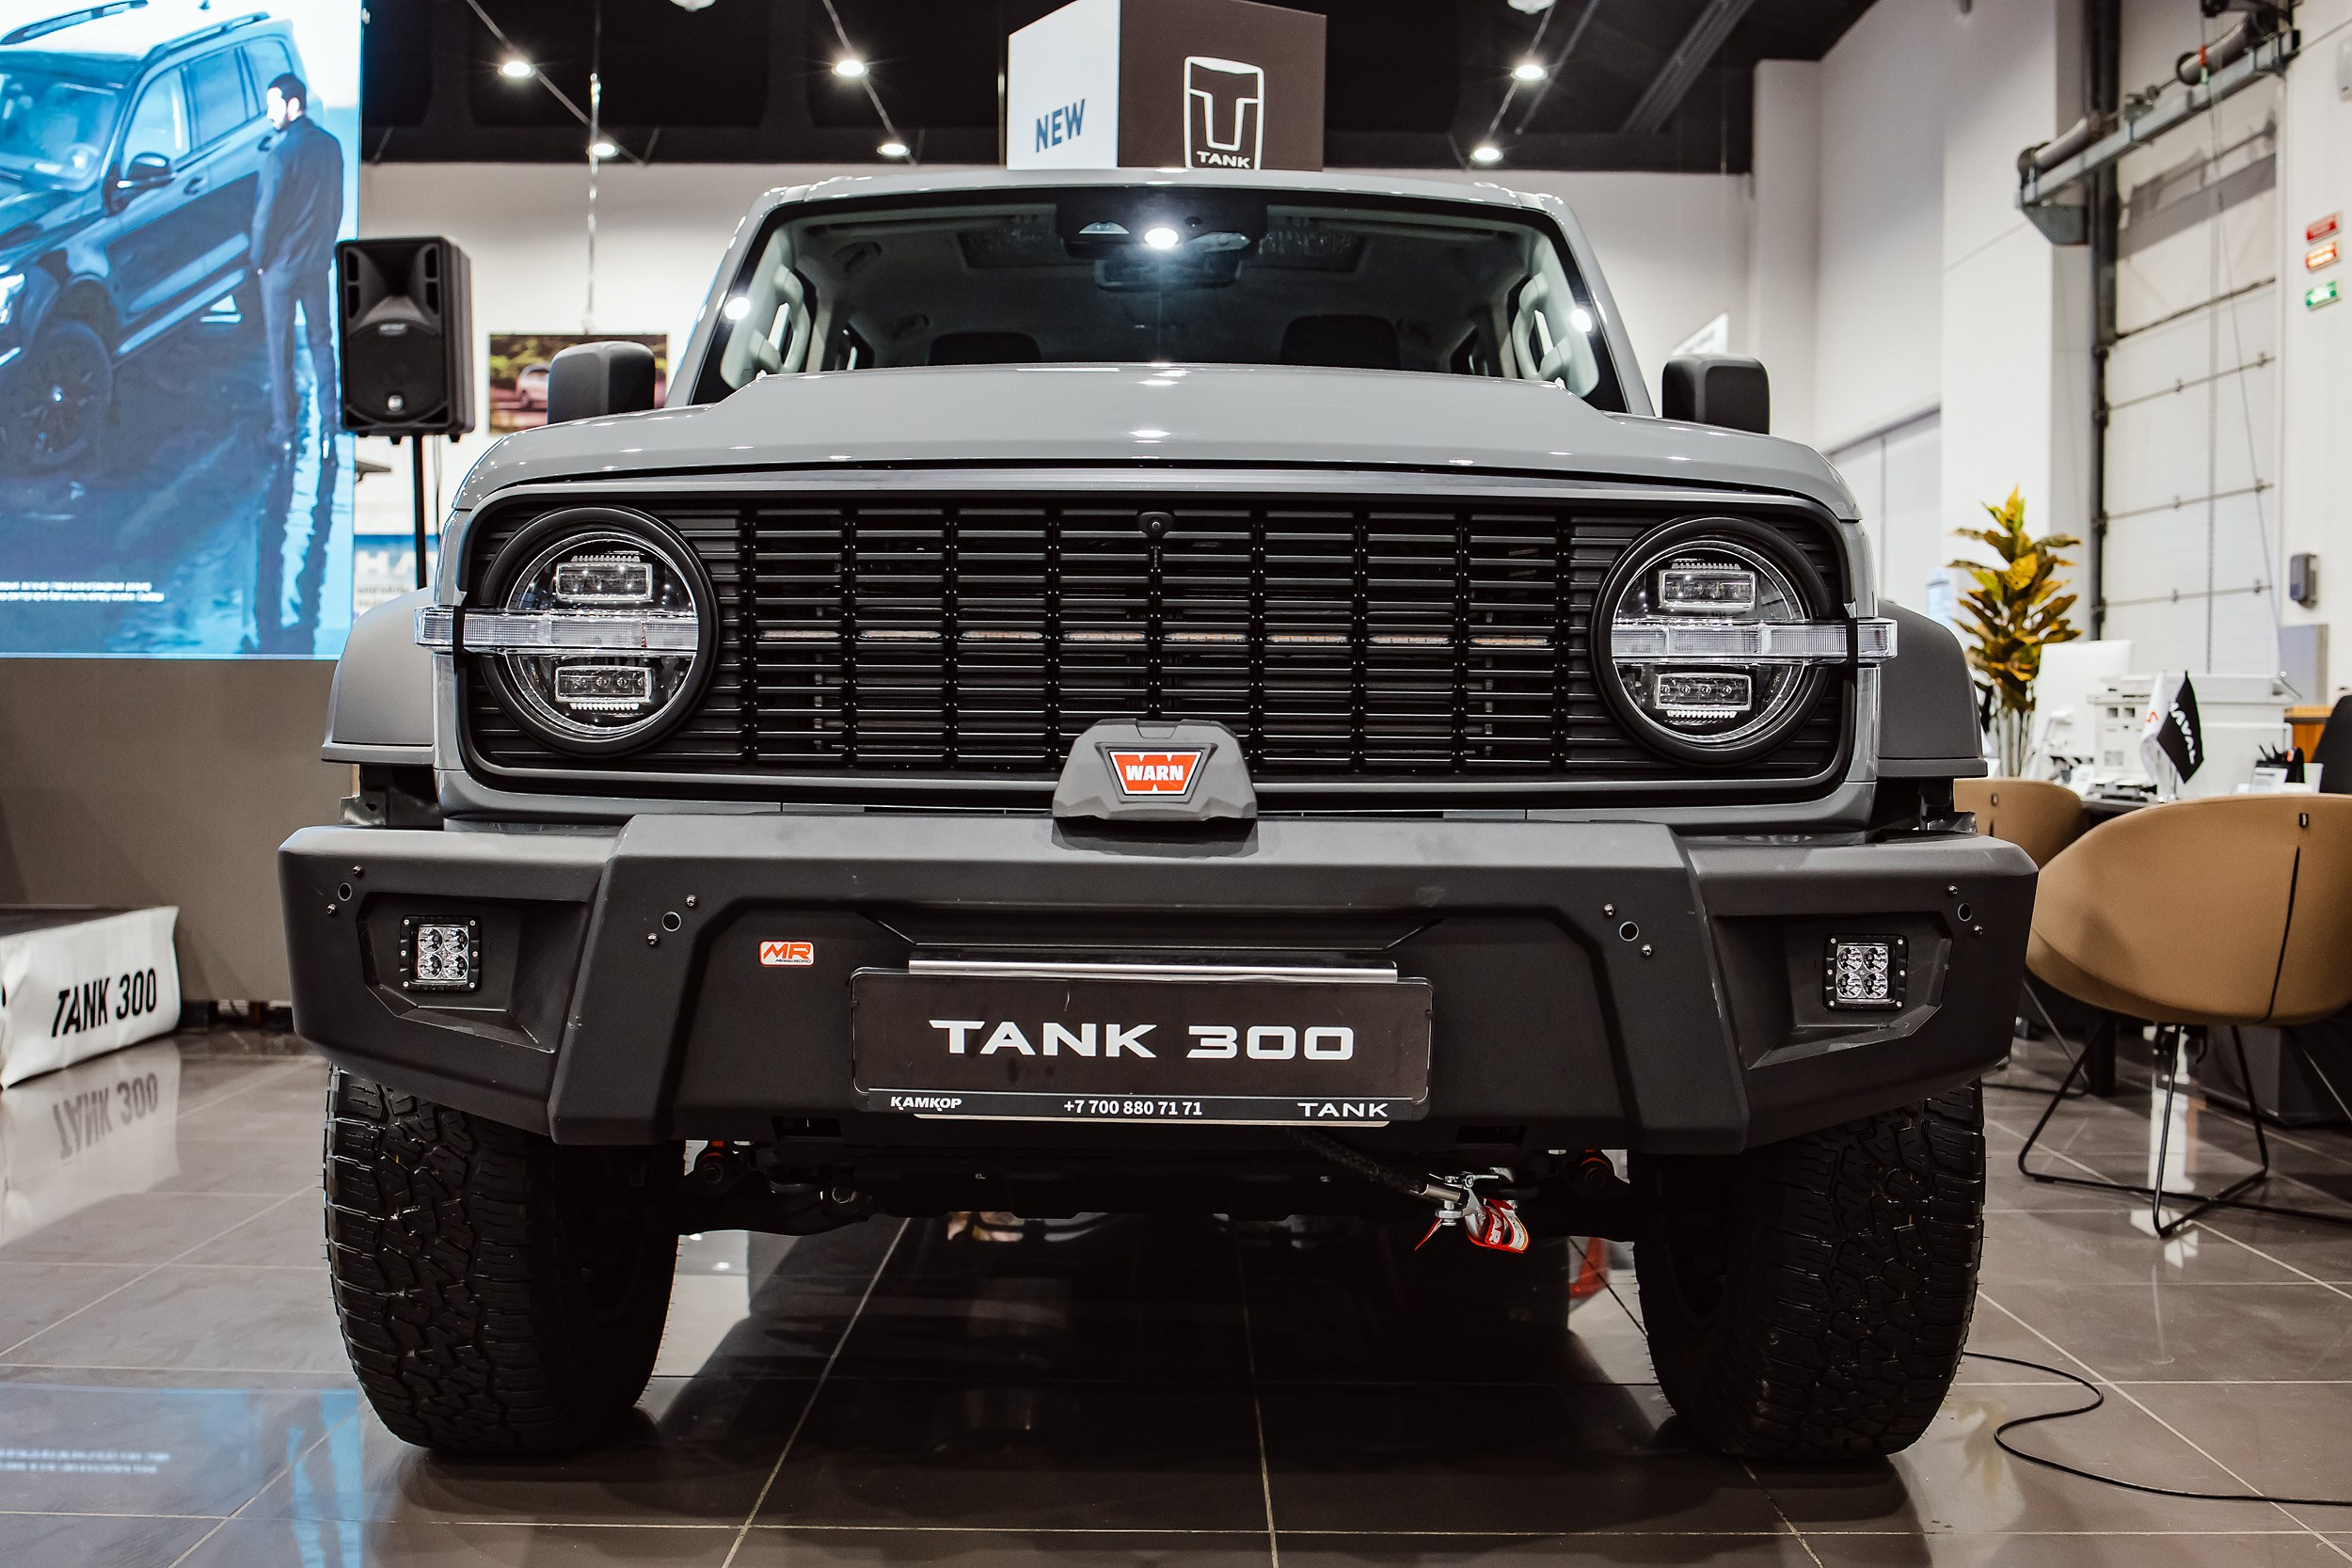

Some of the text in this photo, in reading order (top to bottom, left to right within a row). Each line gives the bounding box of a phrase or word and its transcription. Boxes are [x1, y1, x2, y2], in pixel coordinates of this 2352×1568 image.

[1035, 98, 1086, 153] NEW
[1196, 150, 1251, 169] TANK
[1125, 765, 1184, 782] WARN
[763, 943, 812, 959] MR
[51, 968, 157, 1037] TANK 300
[929, 1020, 1355, 1061] TANK 300
[1063, 1100, 1202, 1116] +7 700 880 71 71
[1296, 1102, 1389, 1117] TANK
